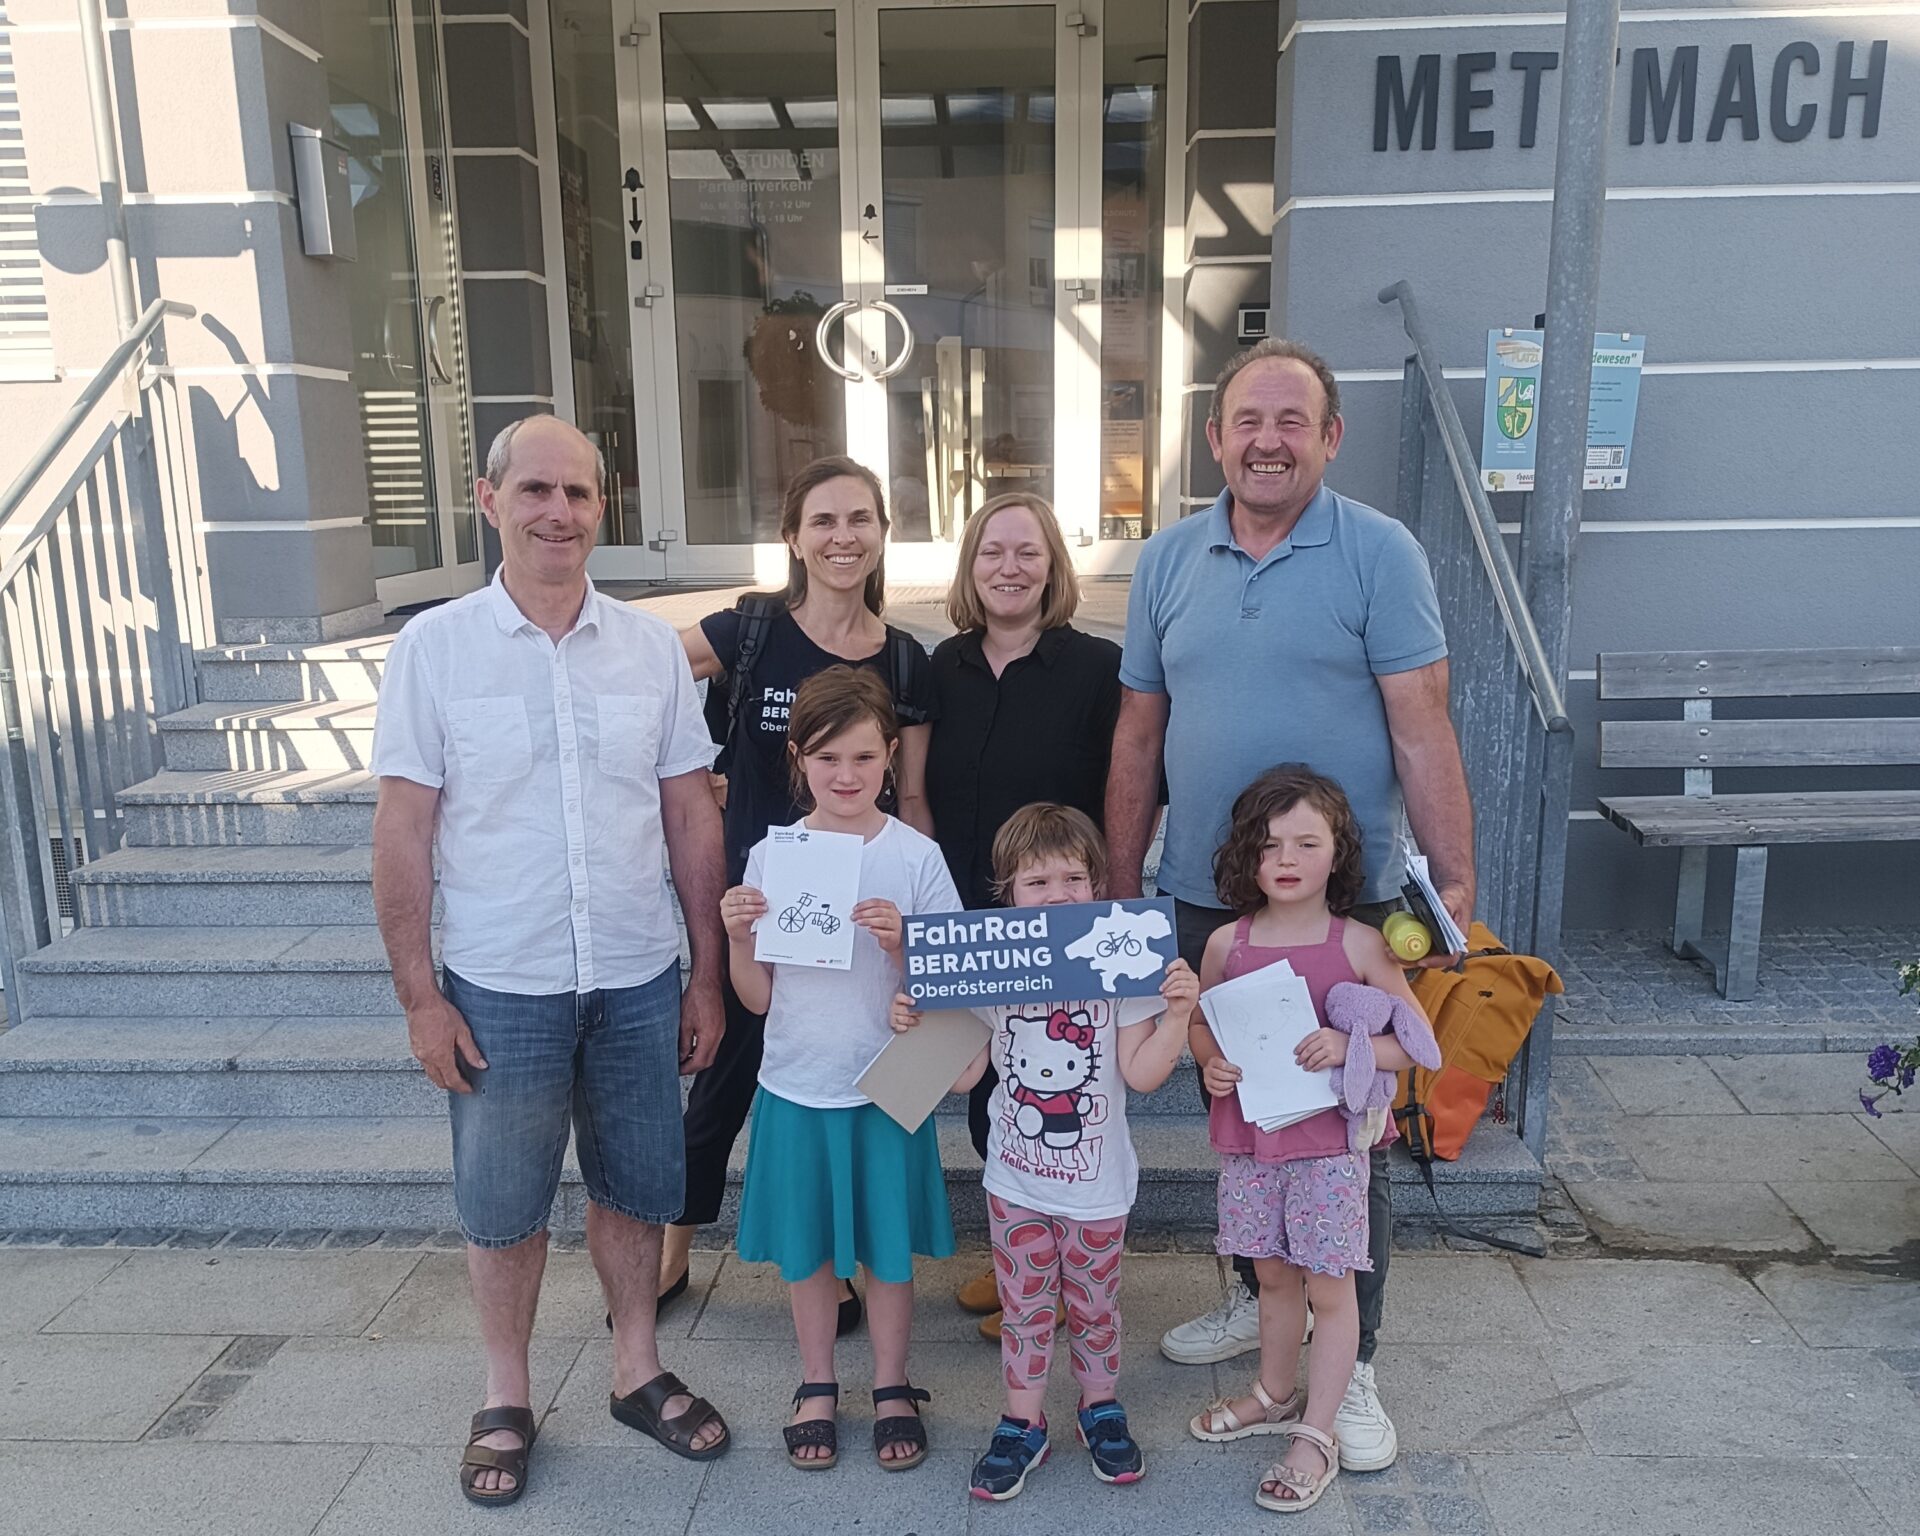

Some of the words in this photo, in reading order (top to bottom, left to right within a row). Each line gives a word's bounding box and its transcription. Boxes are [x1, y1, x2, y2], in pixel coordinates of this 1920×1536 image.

[1373, 39, 1888, 152] METMACH
[795, 200, 812, 209] Uhr
[787, 214, 803, 223] Uhr
[761, 706, 790, 719] BER
[907, 912, 1049, 948] FahrRad
[908, 946, 1053, 976] BERATUNG
[910, 974, 1054, 999] Oberösterreich
[999, 1149, 1031, 1174] Hello
[1034, 1166, 1076, 1184] Kitty
